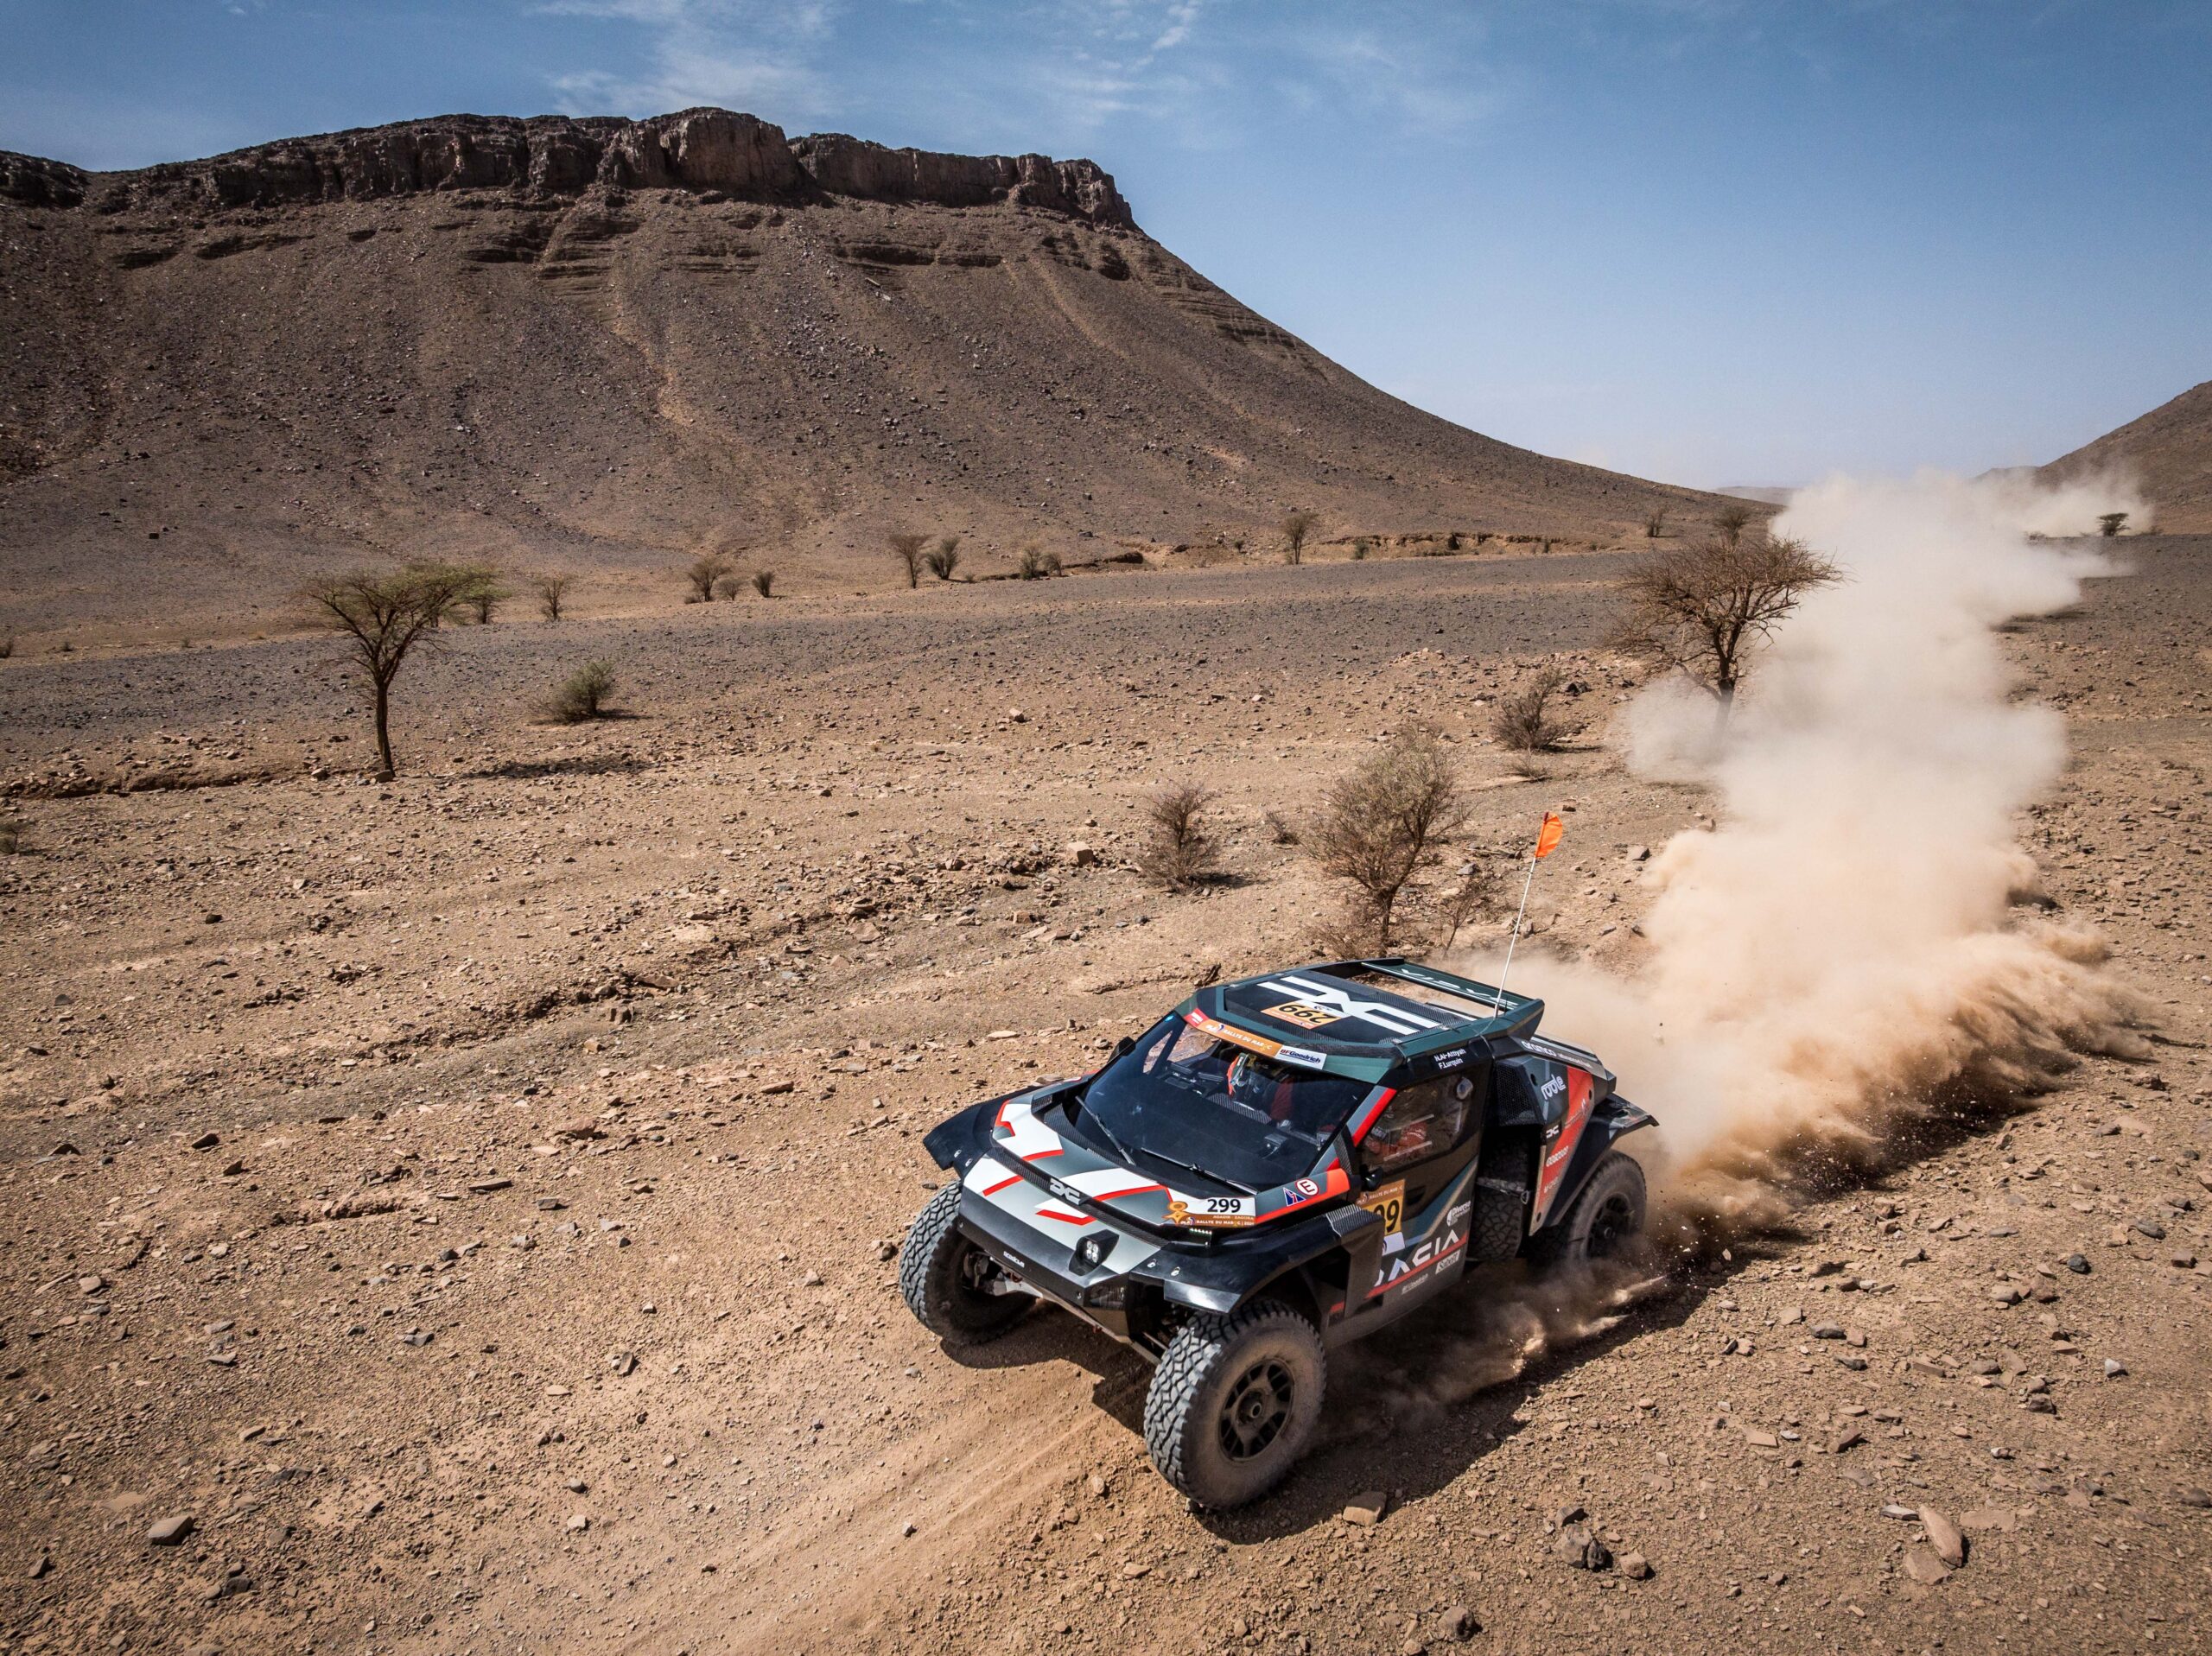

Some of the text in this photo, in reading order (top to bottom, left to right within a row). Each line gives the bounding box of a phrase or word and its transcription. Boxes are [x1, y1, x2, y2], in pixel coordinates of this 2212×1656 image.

[1278, 1005, 1338, 1024] 299
[1280, 1049, 1321, 1063] BFGoodrich
[1207, 1198, 1241, 1214] 299
